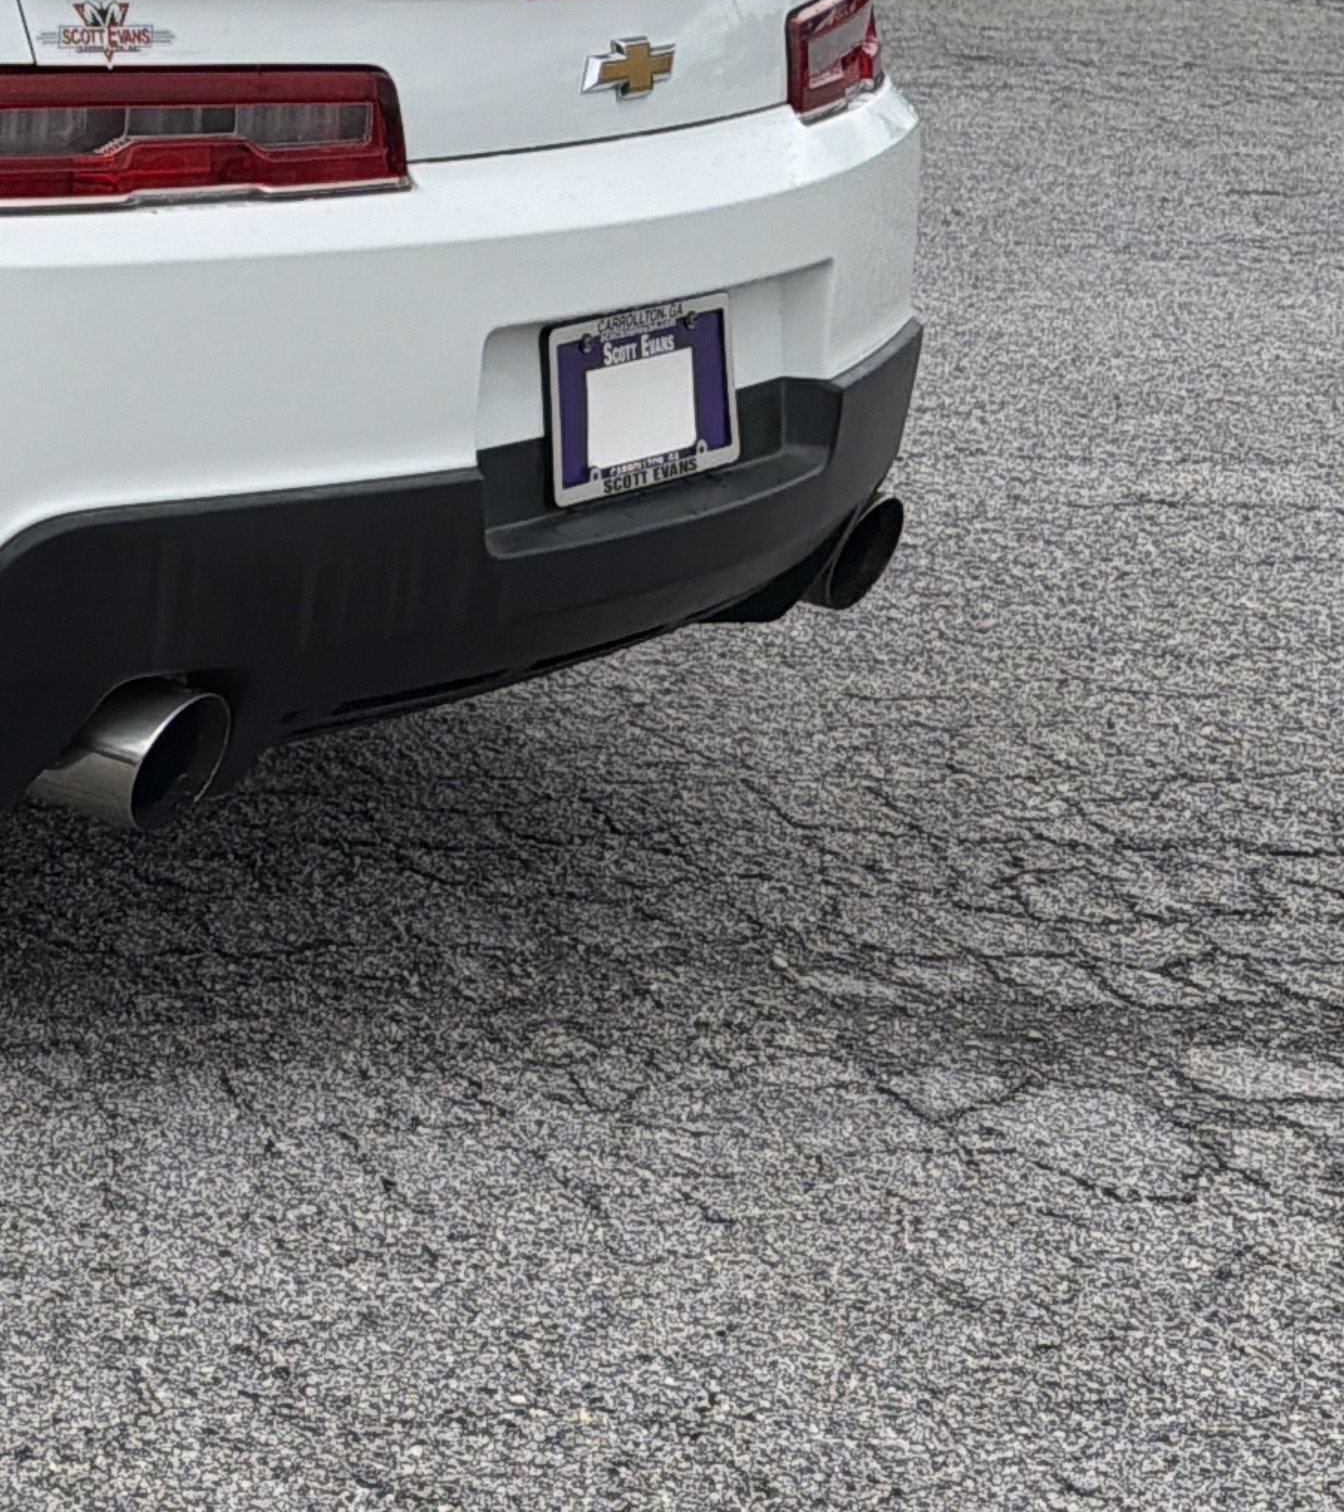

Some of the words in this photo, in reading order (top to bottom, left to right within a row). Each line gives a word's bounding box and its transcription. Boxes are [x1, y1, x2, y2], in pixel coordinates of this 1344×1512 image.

[61, 28, 104, 45] SCOTT
[108, 25, 151, 46] EVANS
[669, 302, 684, 319] GA
[603, 341, 638, 366] SCOTT
[640, 334, 675, 357] EVANS
[603, 471, 648, 495] SCOTT
[653, 457, 698, 479] EVANS
